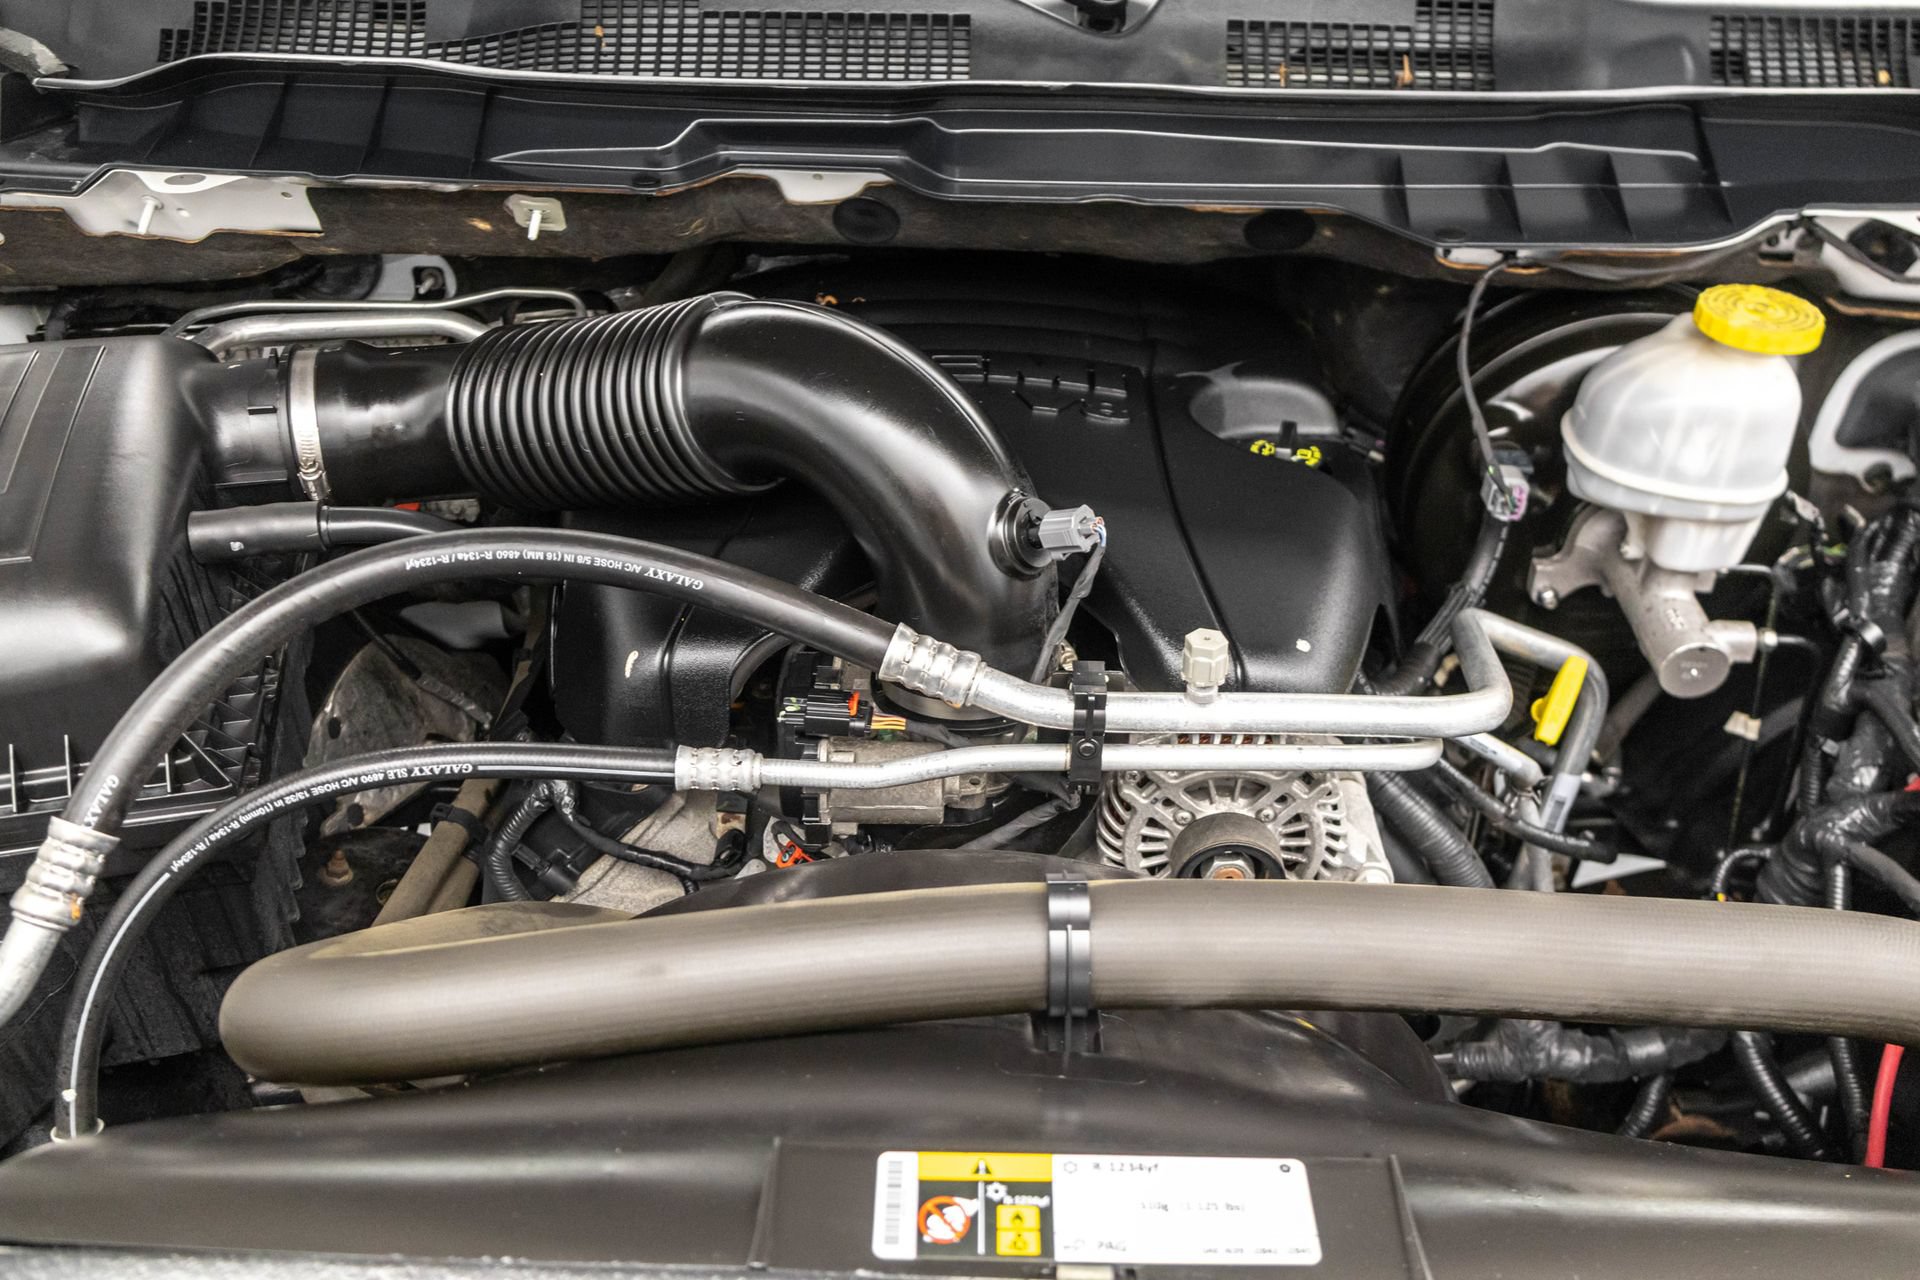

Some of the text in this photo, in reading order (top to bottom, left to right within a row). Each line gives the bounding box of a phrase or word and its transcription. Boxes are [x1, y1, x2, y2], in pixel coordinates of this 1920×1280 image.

[457, 551, 492, 561] R-134a
[496, 550, 520, 560] 4860
[522, 549, 544, 560] MM)
[546, 551, 561, 561] (16
[563, 553, 574, 562] IN
[577, 555, 591, 565] 5/8
[405, 554, 449, 570] R-1234yf
[593, 557, 622, 570] HOSE
[624, 563, 643, 573] A/C
[644, 567, 704, 590] GALAXY
[386, 767, 408, 780] SLE
[411, 763, 473, 777] GALAXY
[340, 777, 359, 787] A/C
[361, 773, 384, 784] 4890
[310, 780, 340, 796] HOSE
[274, 797, 285, 807] in
[284, 790, 310, 804] 13/32
[239, 802, 274, 824] (10mm)
[208, 820, 241, 841] R-134a
